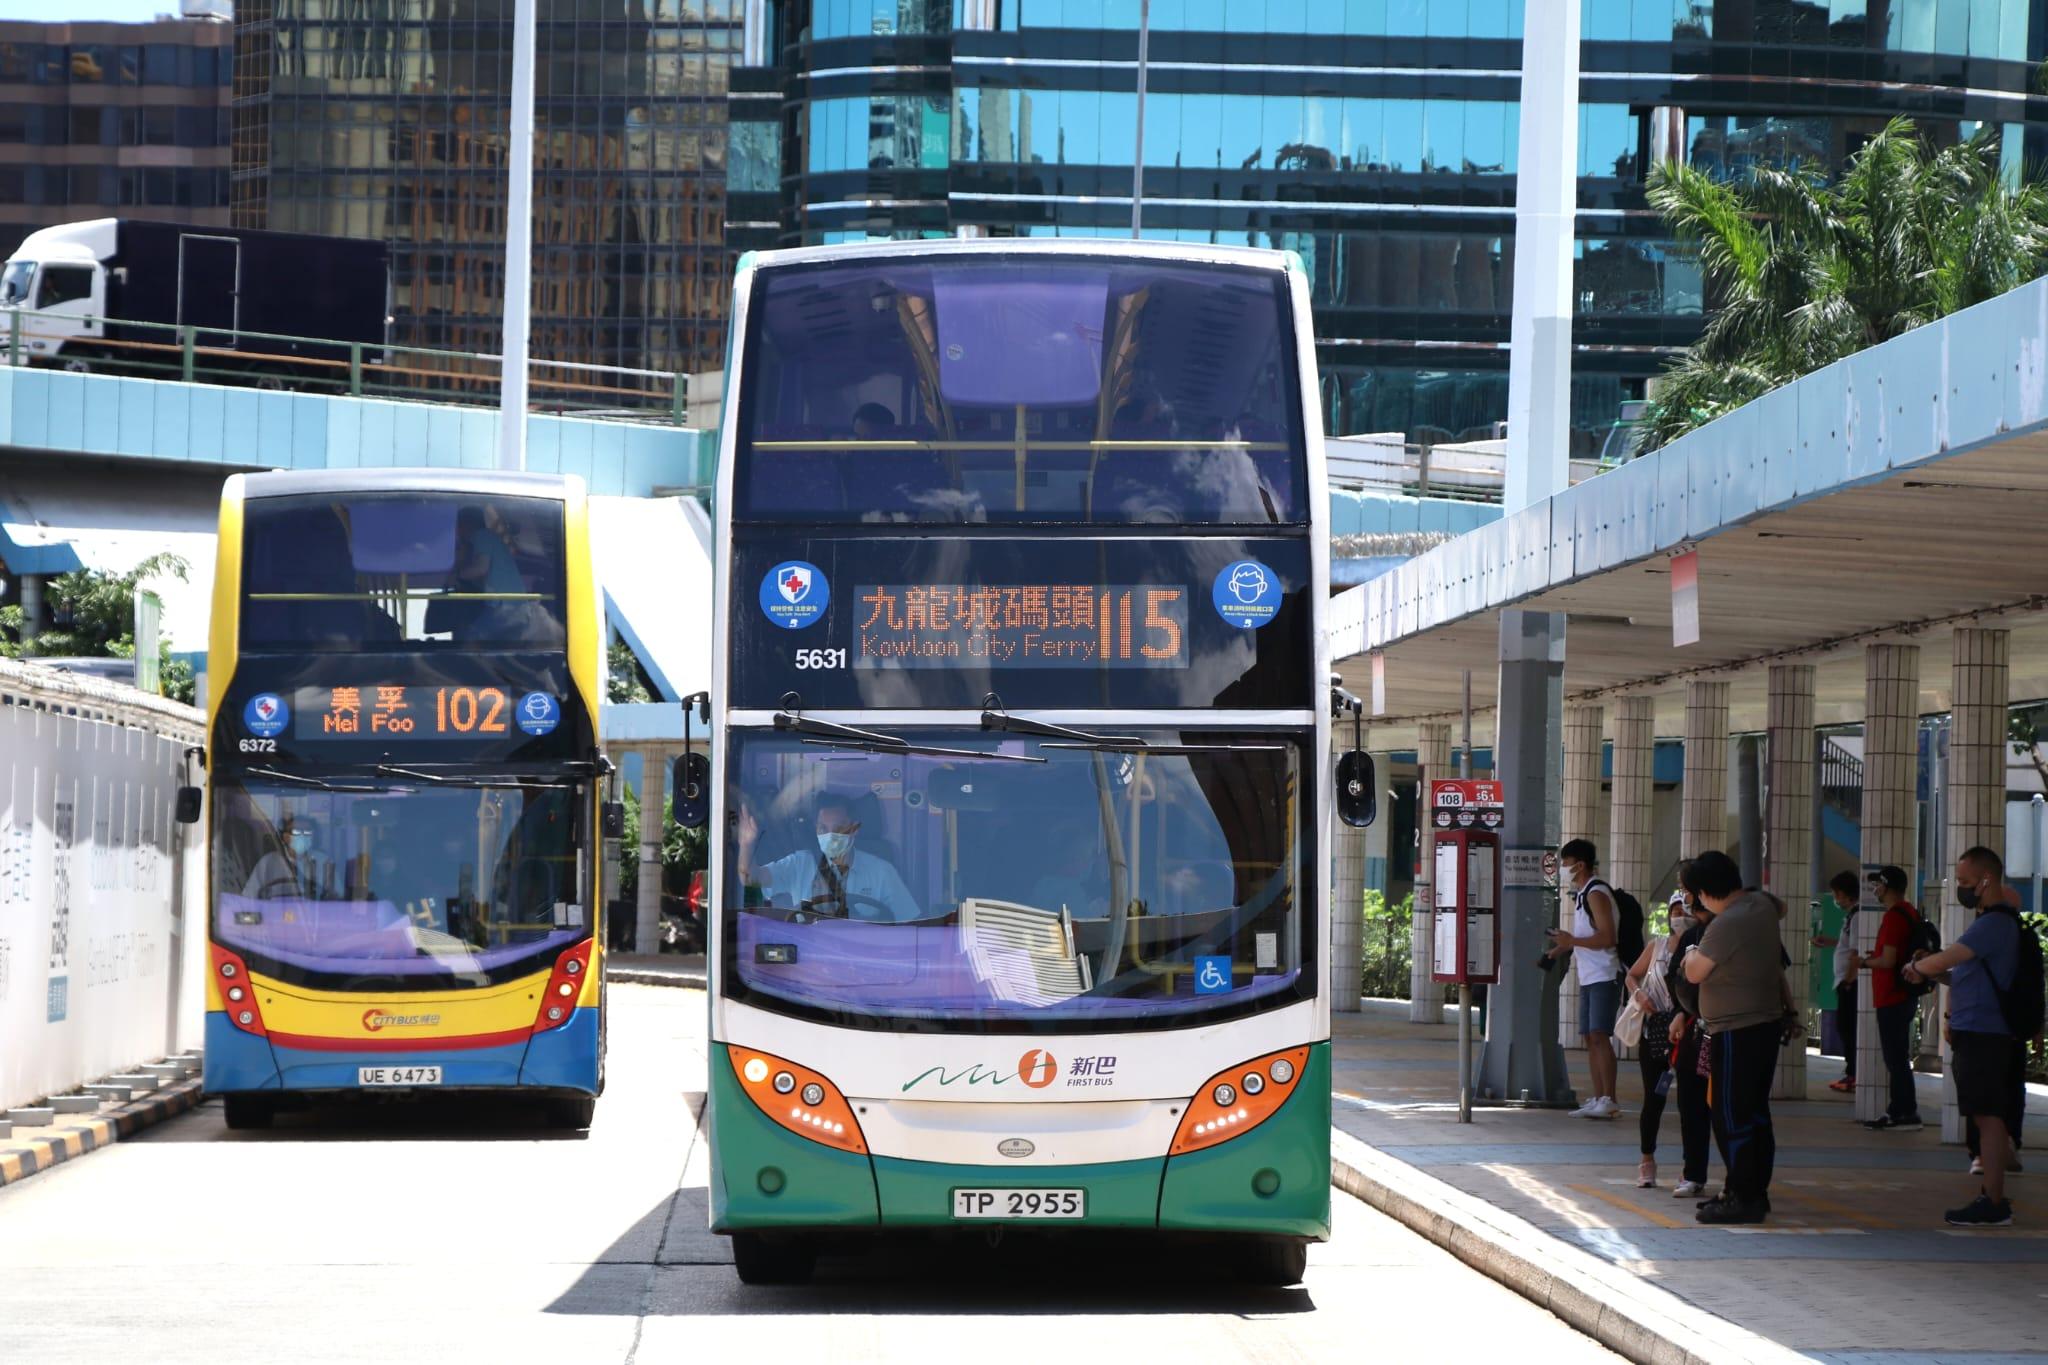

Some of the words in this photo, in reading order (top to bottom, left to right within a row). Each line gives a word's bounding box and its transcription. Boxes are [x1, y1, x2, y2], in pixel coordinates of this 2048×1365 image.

[860, 585, 1095, 630] 九龍城碼頭
[1099, 590, 1182, 659] 115
[860, 634, 959, 657] Kowloon
[967, 634, 1016, 661] City
[1024, 634, 1097, 661] Ferry
[795, 648, 847, 669] 5631
[331, 686, 408, 713] 美孚
[436, 687, 505, 732] 102
[323, 714, 359, 733] Mei
[371, 714, 415, 733] Foo
[239, 739, 276, 752] 6372
[1440, 794, 1460, 805] 108
[363, 1069, 385, 1083] UE
[392, 1069, 437, 1083] 6473
[1070, 1056, 1117, 1076] 新巴
[1067, 1078, 1093, 1087] FIRST
[1094, 1078, 1113, 1087] BUS
[960, 1192, 994, 1214] TP
[1007, 1192, 1078, 1214] 2955
